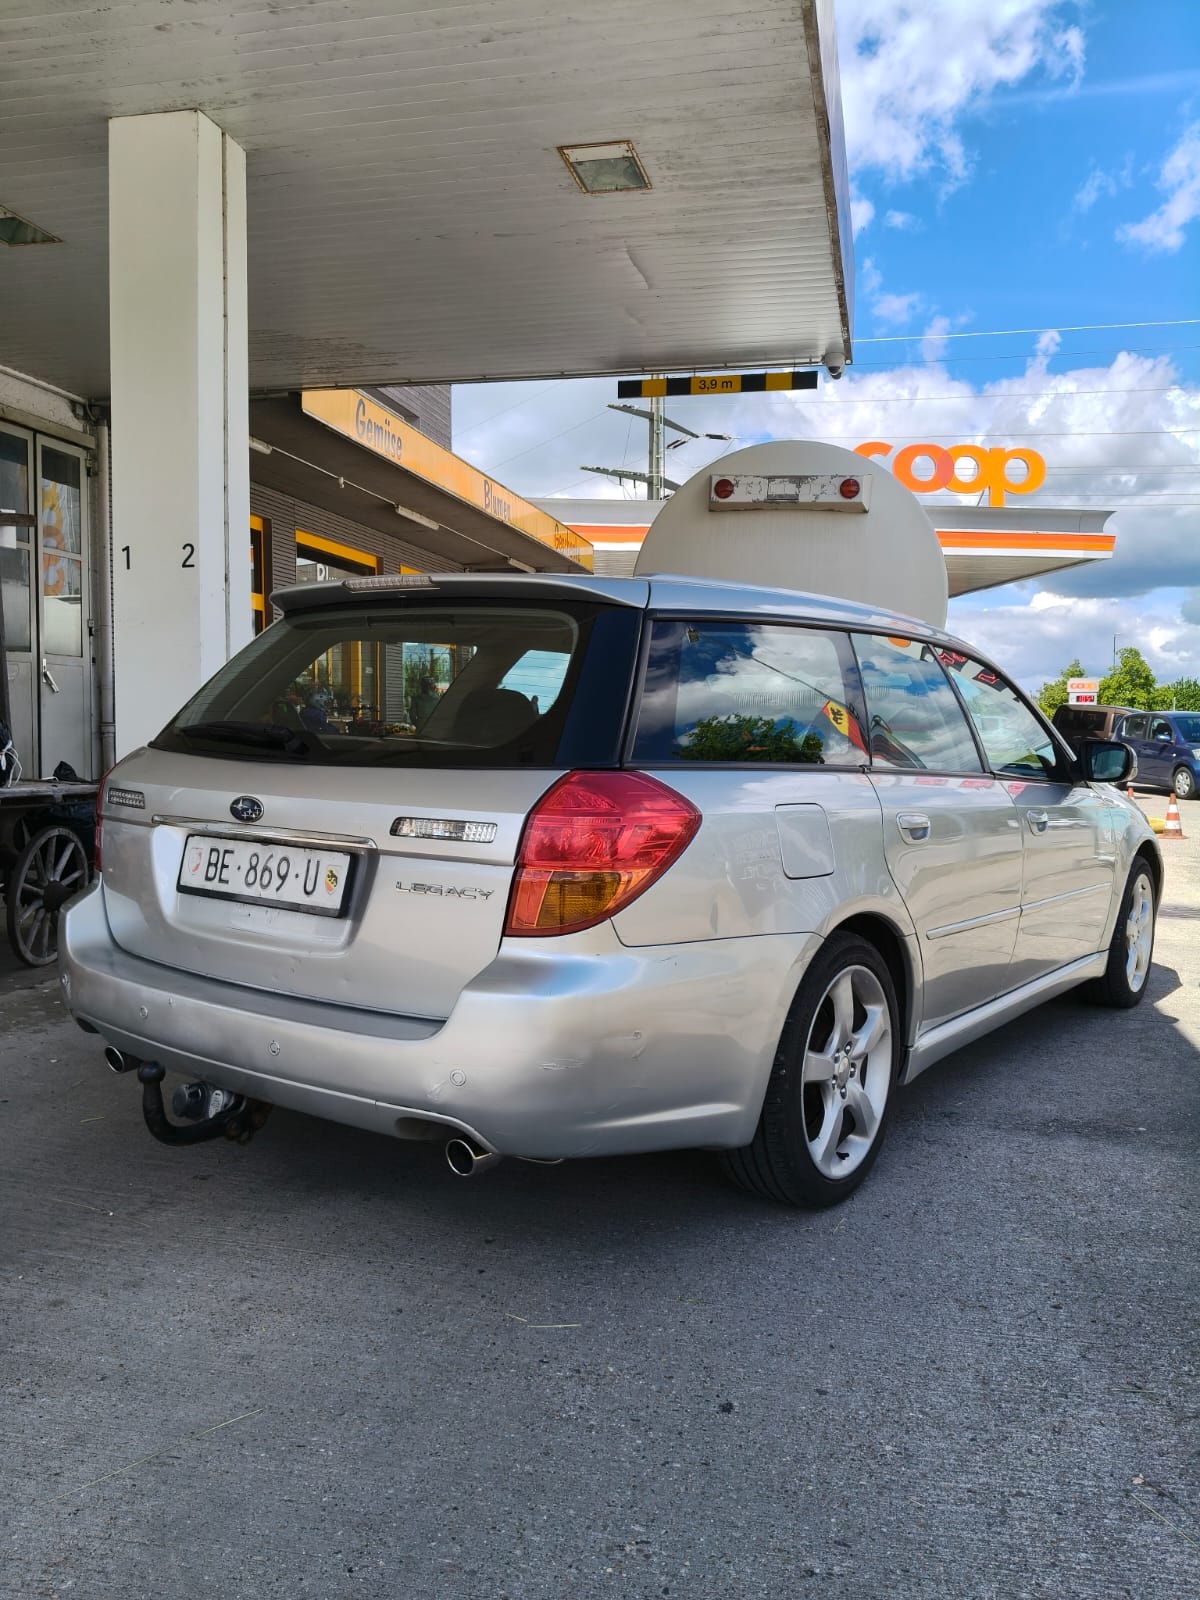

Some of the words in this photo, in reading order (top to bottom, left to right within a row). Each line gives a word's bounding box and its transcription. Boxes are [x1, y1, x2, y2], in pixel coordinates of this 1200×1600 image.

[698, 378, 718, 392] 3,9
[721, 380, 733, 389] m
[355, 398, 403, 460] Gemüse
[483, 479, 512, 521] Blumen
[121, 545, 131, 570] 1
[181, 543, 196, 568] 2
[395, 880, 495, 900] LEGACY
